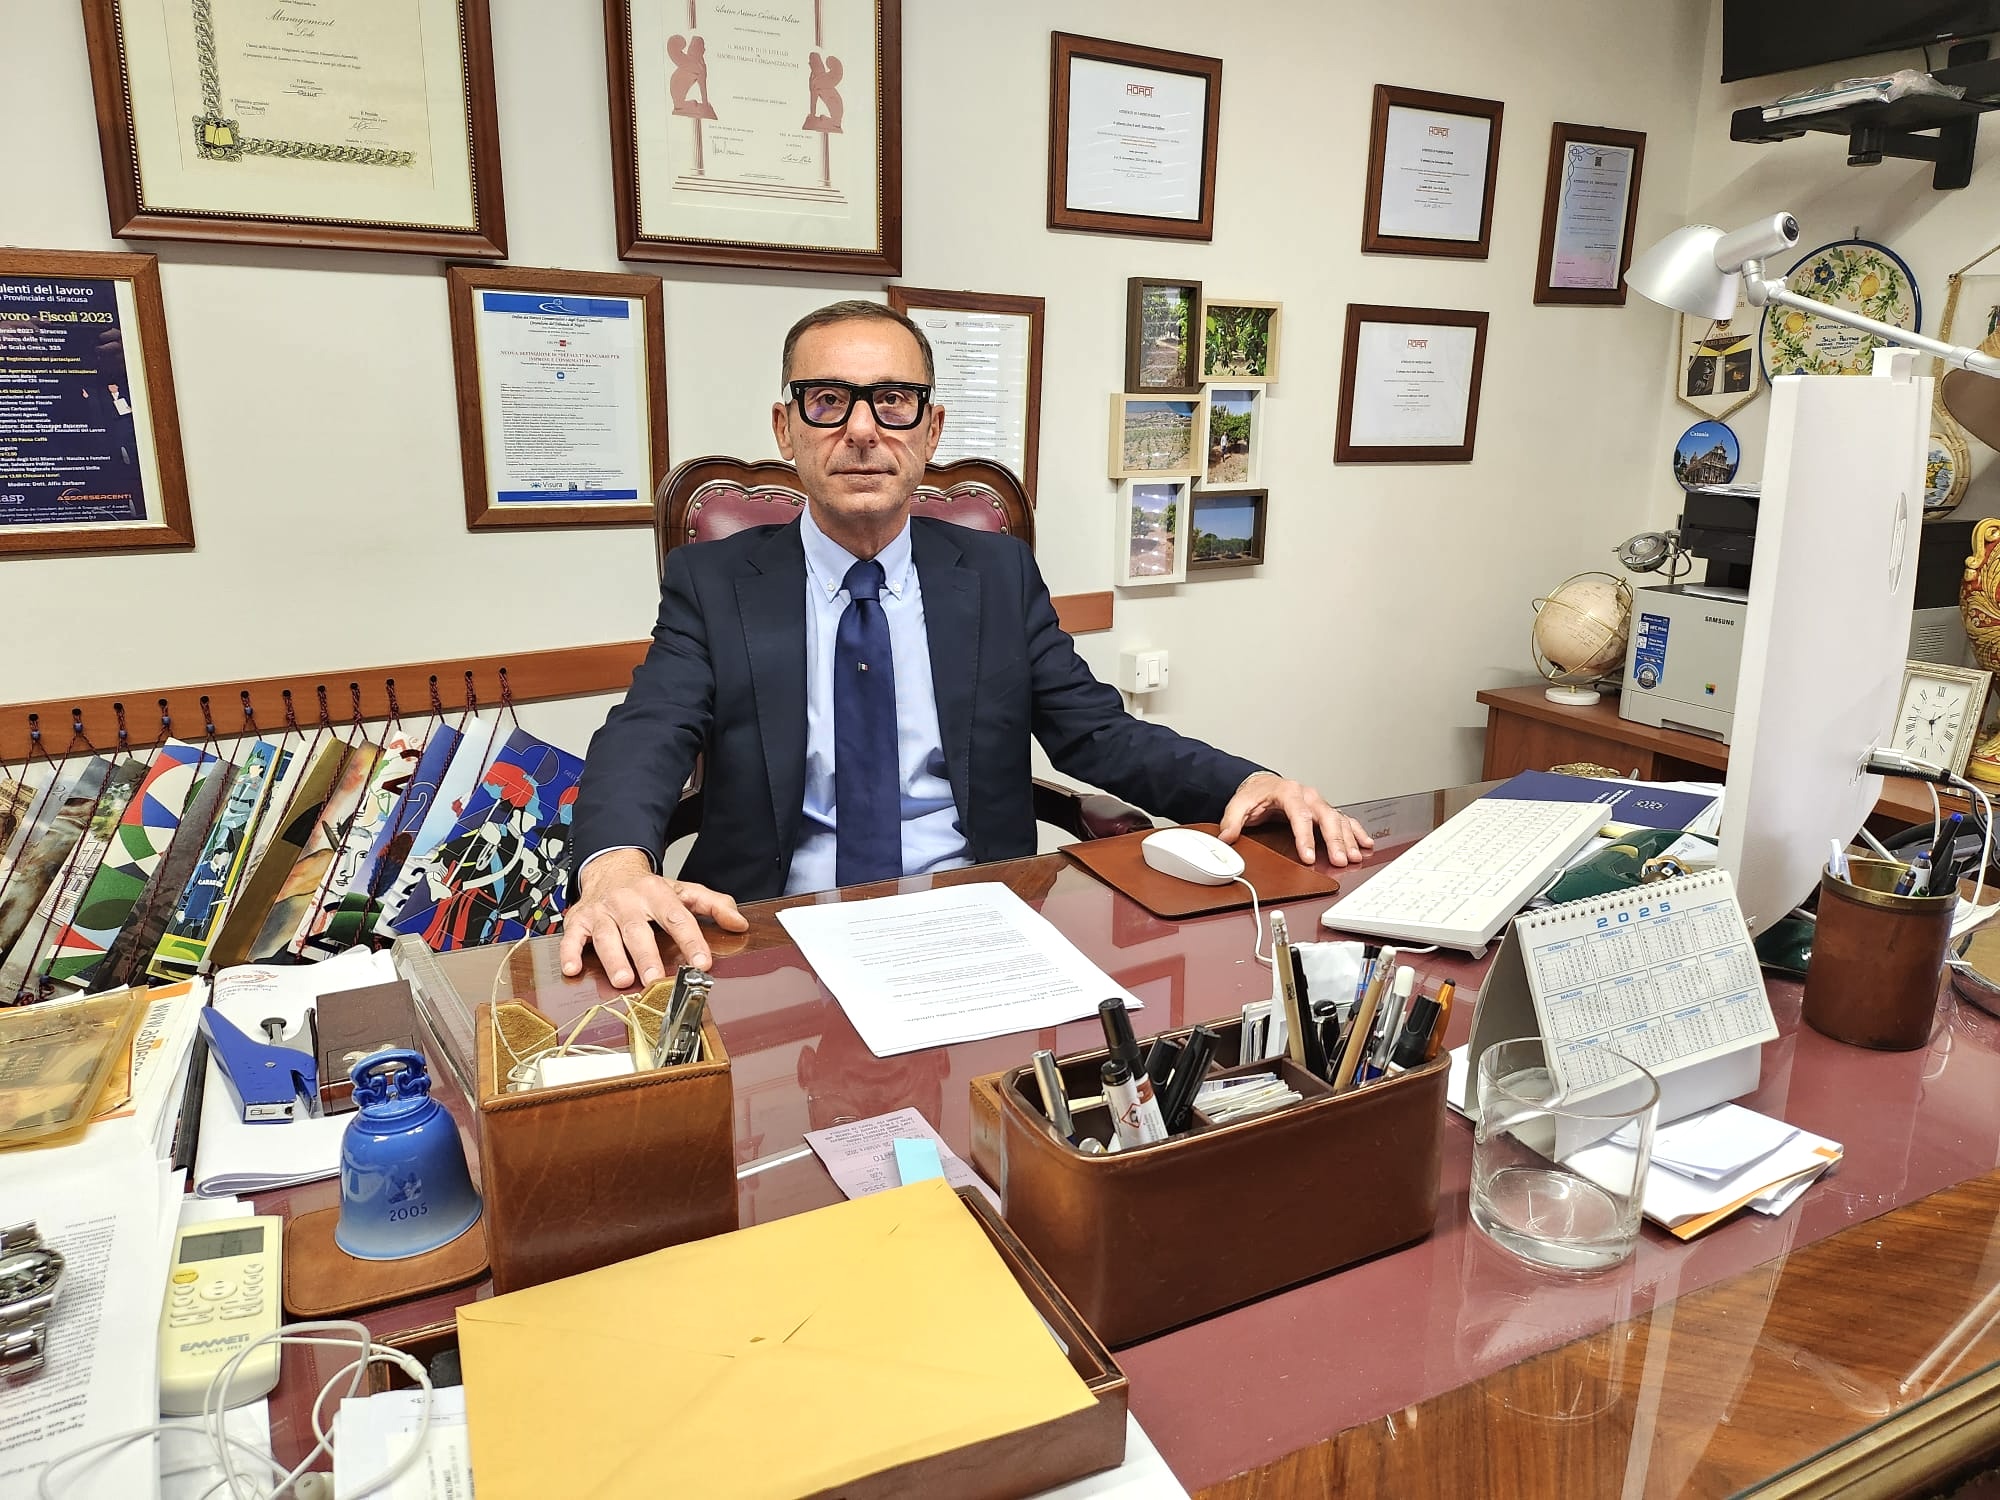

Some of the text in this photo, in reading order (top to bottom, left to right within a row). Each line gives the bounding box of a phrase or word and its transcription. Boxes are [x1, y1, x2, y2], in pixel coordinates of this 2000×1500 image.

[265, 8, 337, 28] Management
[33, 285, 52, 295] del
[55, 285, 94, 296] lavoro
[3, 294, 46, 303] Provinciale
[56, 295, 88, 303] Siracusa
[39, 311, 79, 322] Fiscali
[80, 312, 114, 323] 2023
[1704, 615, 1735, 626] SAMSUNG
[1597, 902, 1672, 929] 2025
[1653, 917, 1671, 925] MARZO
[1599, 928, 1624, 939] FEBBRAIO
[1547, 942, 1572, 952] GENNAIO
[1560, 990, 1583, 1000] MAGGIO
[1674, 1007, 1701, 1019] NOVEMBRE
[1626, 1022, 1648, 1033] OTTOBRE
[389, 1201, 429, 1222] 2005
